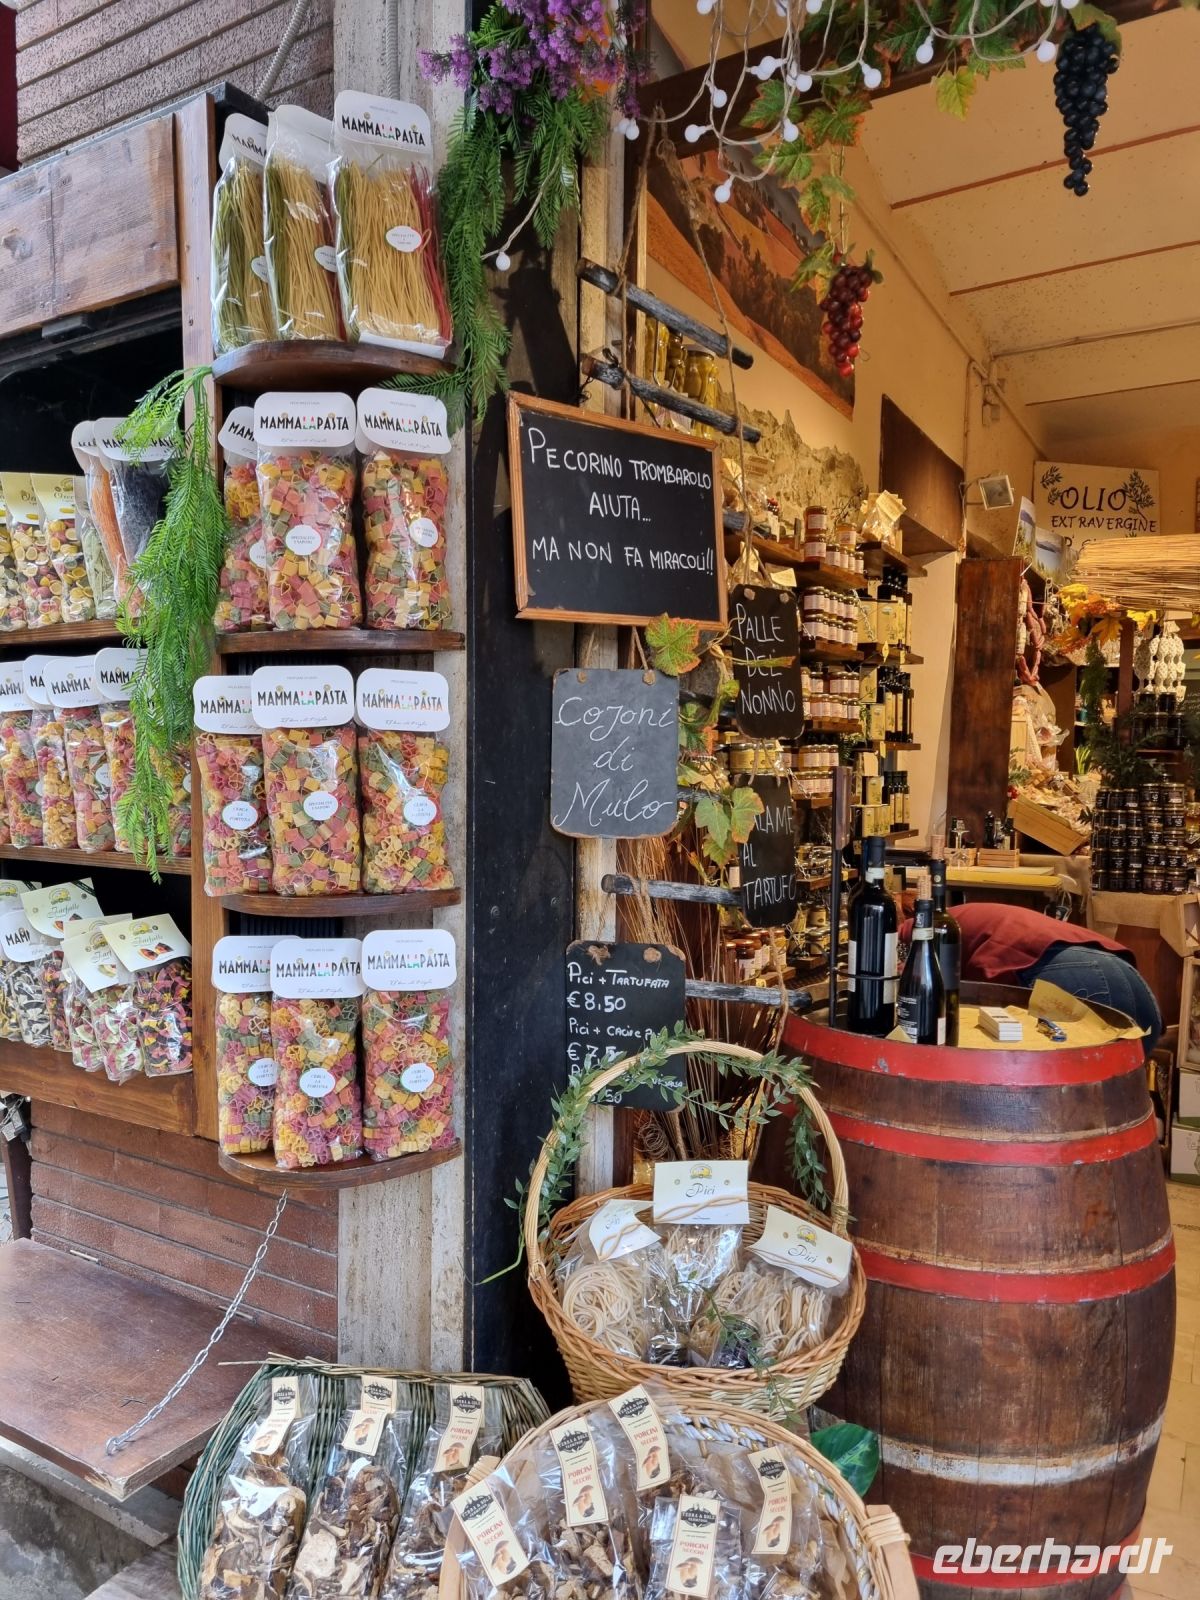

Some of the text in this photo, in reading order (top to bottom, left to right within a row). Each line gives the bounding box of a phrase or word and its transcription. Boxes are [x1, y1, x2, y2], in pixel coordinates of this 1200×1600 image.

[527, 427, 713, 491] PECORINO TROMBAROLO
[1060, 485, 1128, 512] OLIO
[532, 536, 561, 562] MA
[568, 539, 614, 565] NON
[624, 546, 645, 569] FA
[735, 602, 785, 645] PALLE
[740, 684, 797, 716] NONNO
[593, 736, 636, 773] di
[552, 777, 674, 829] Mulo
[754, 804, 794, 835] LAME
[743, 843, 758, 868] AL
[567, 961, 594, 985] Pici
[605, 968, 671, 989] TARTUFATA
[568, 1017, 590, 1036] Pici
[685, 1182, 716, 1199] Pici
[787, 1244, 819, 1265] Pici
[680, 1541, 710, 1550] PORCINI
